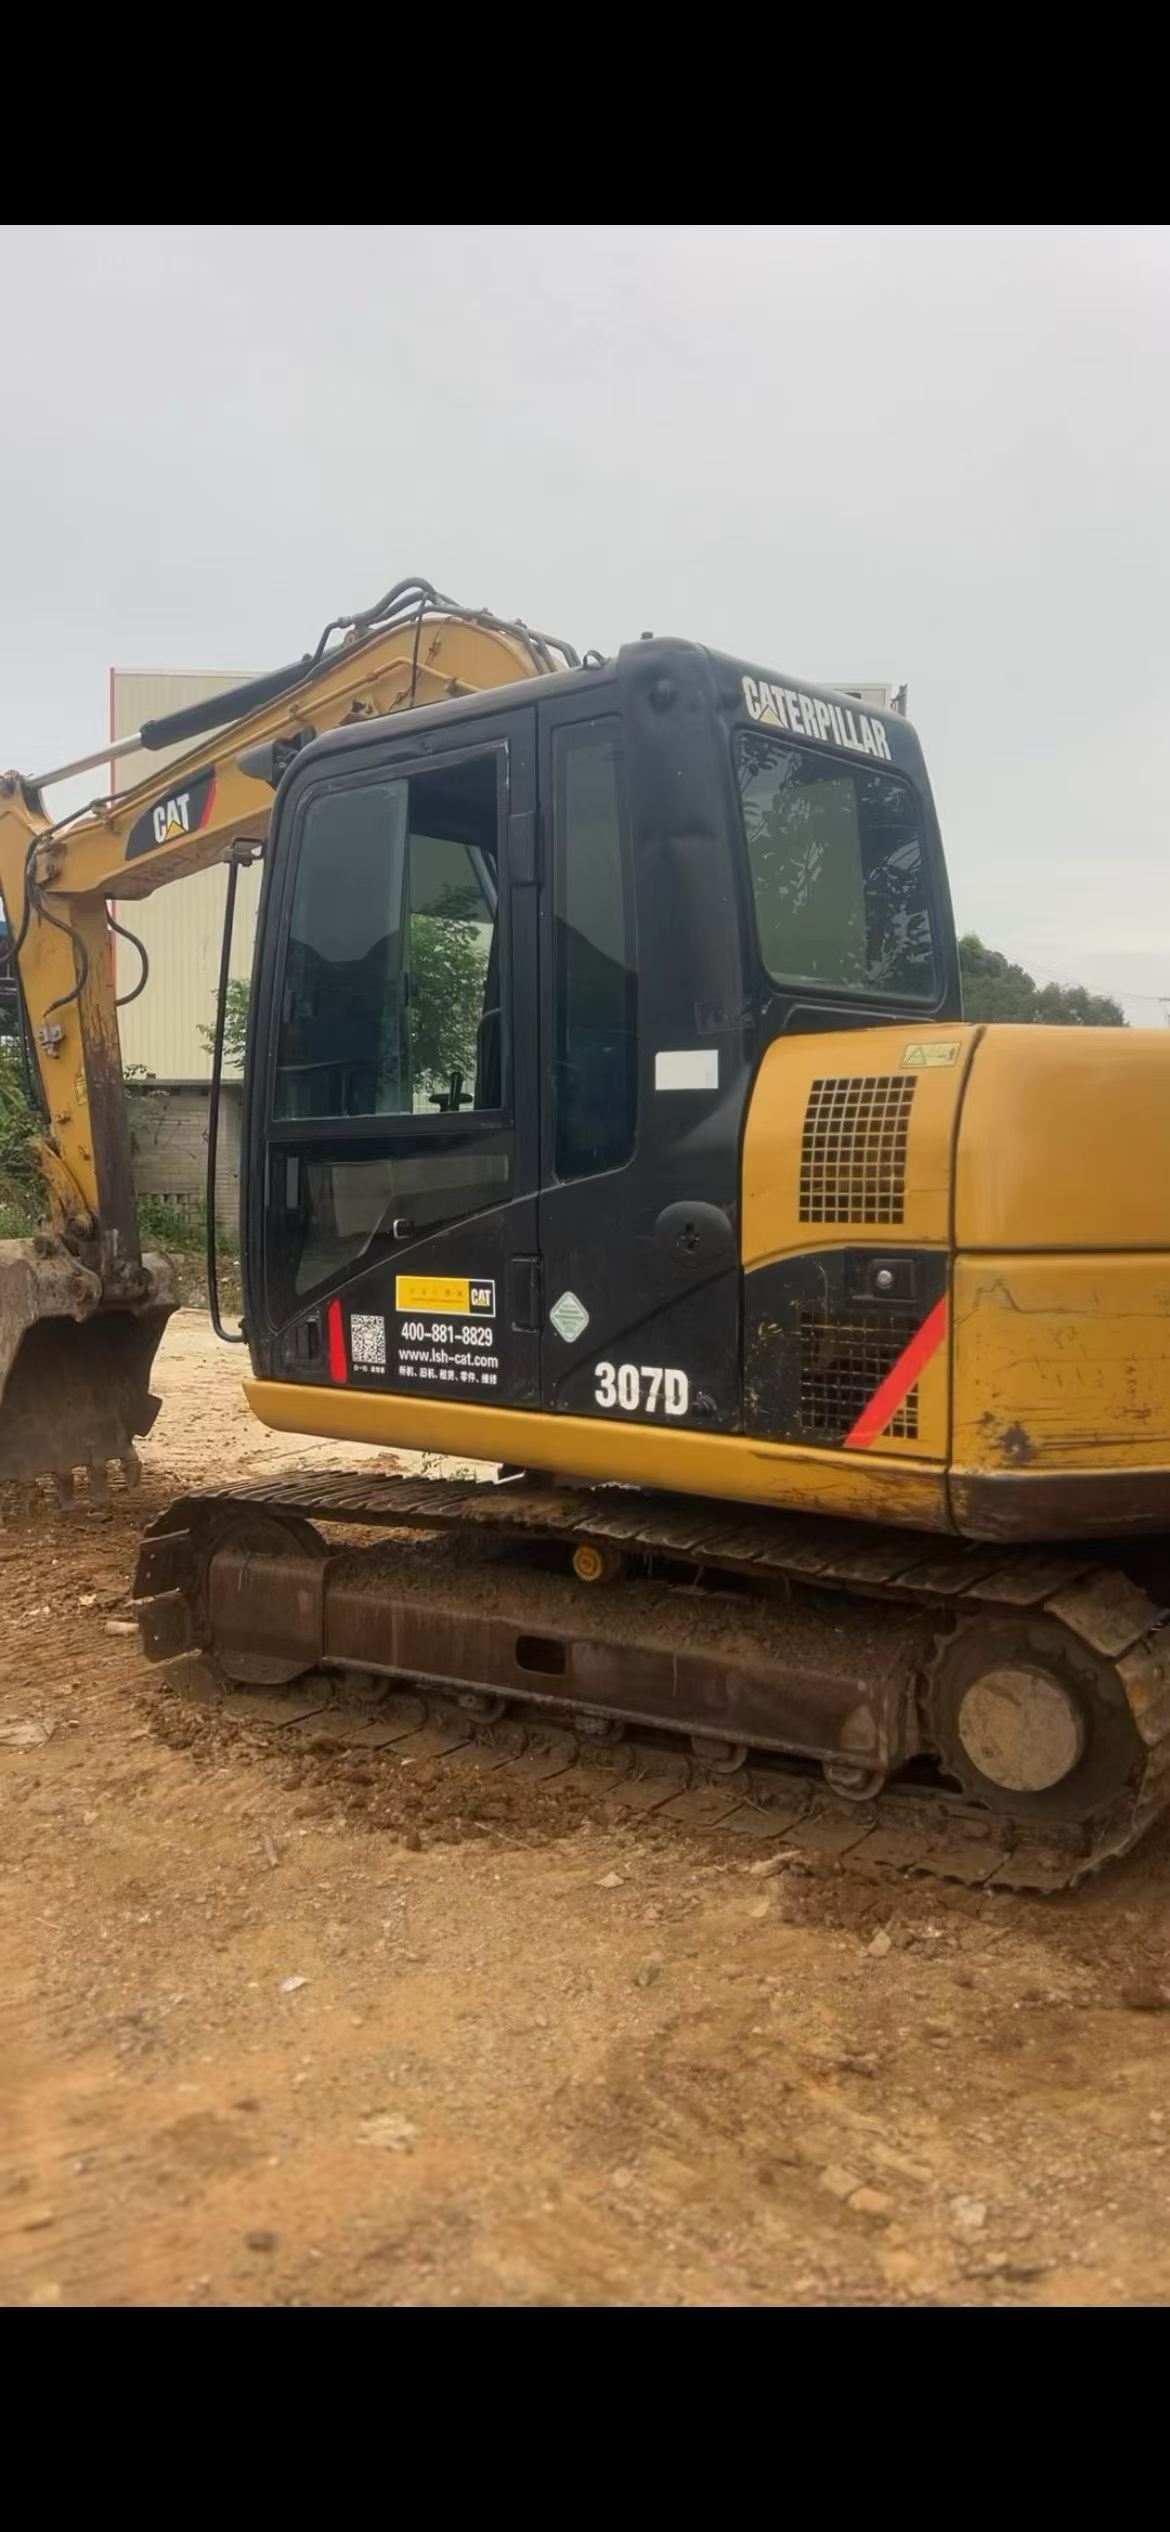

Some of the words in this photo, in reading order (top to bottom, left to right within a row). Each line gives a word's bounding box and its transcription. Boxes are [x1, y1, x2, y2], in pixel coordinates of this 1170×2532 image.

[742, 676, 892, 760] CATERPILLAR
[153, 793, 190, 843] CAT
[471, 1288, 491, 1306] CAT
[401, 1322, 493, 1346] 400-881-8829
[399, 1348, 498, 1368] www.lsh-cat.com
[595, 1361, 688, 1415] 307D
